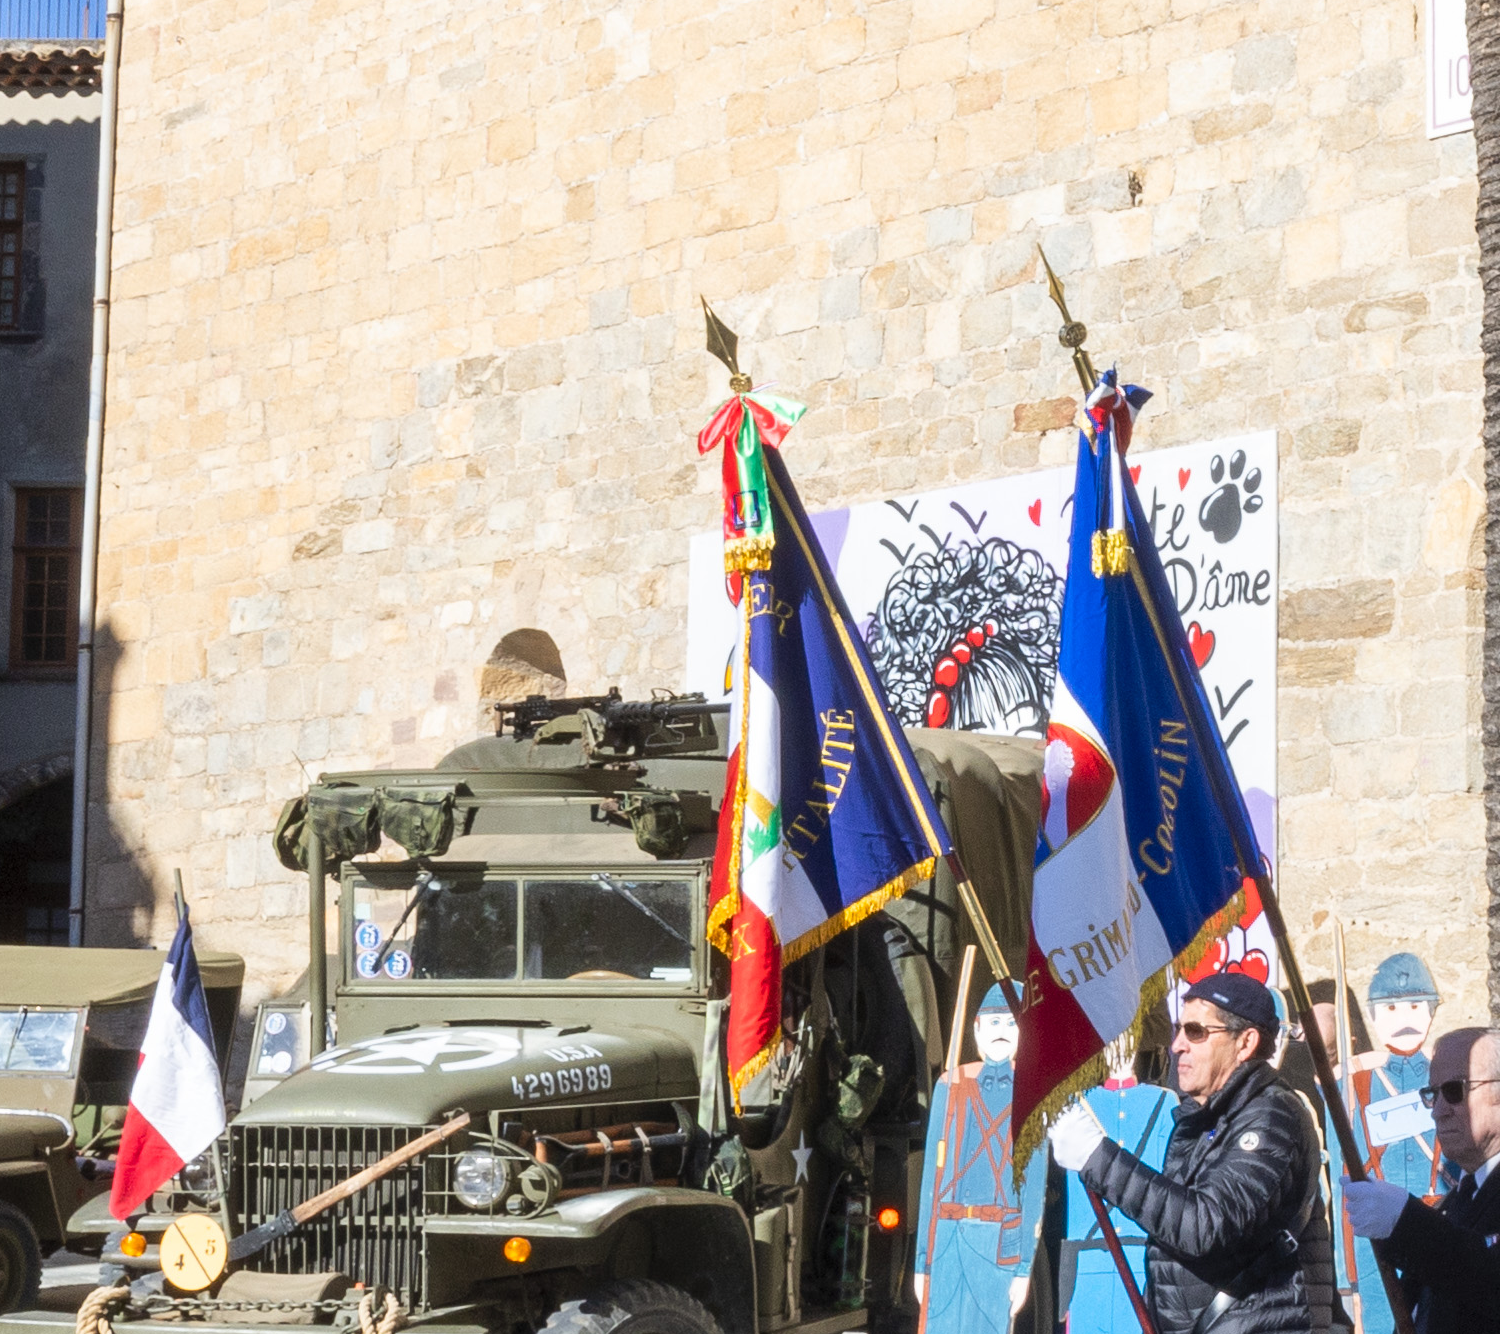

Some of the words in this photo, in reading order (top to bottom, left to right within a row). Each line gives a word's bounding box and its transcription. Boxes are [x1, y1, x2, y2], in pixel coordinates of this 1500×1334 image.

[511, 1064, 612, 1100] 4296989
[205, 1239, 216, 1256] 5
[174, 1253, 185, 1271] 4
